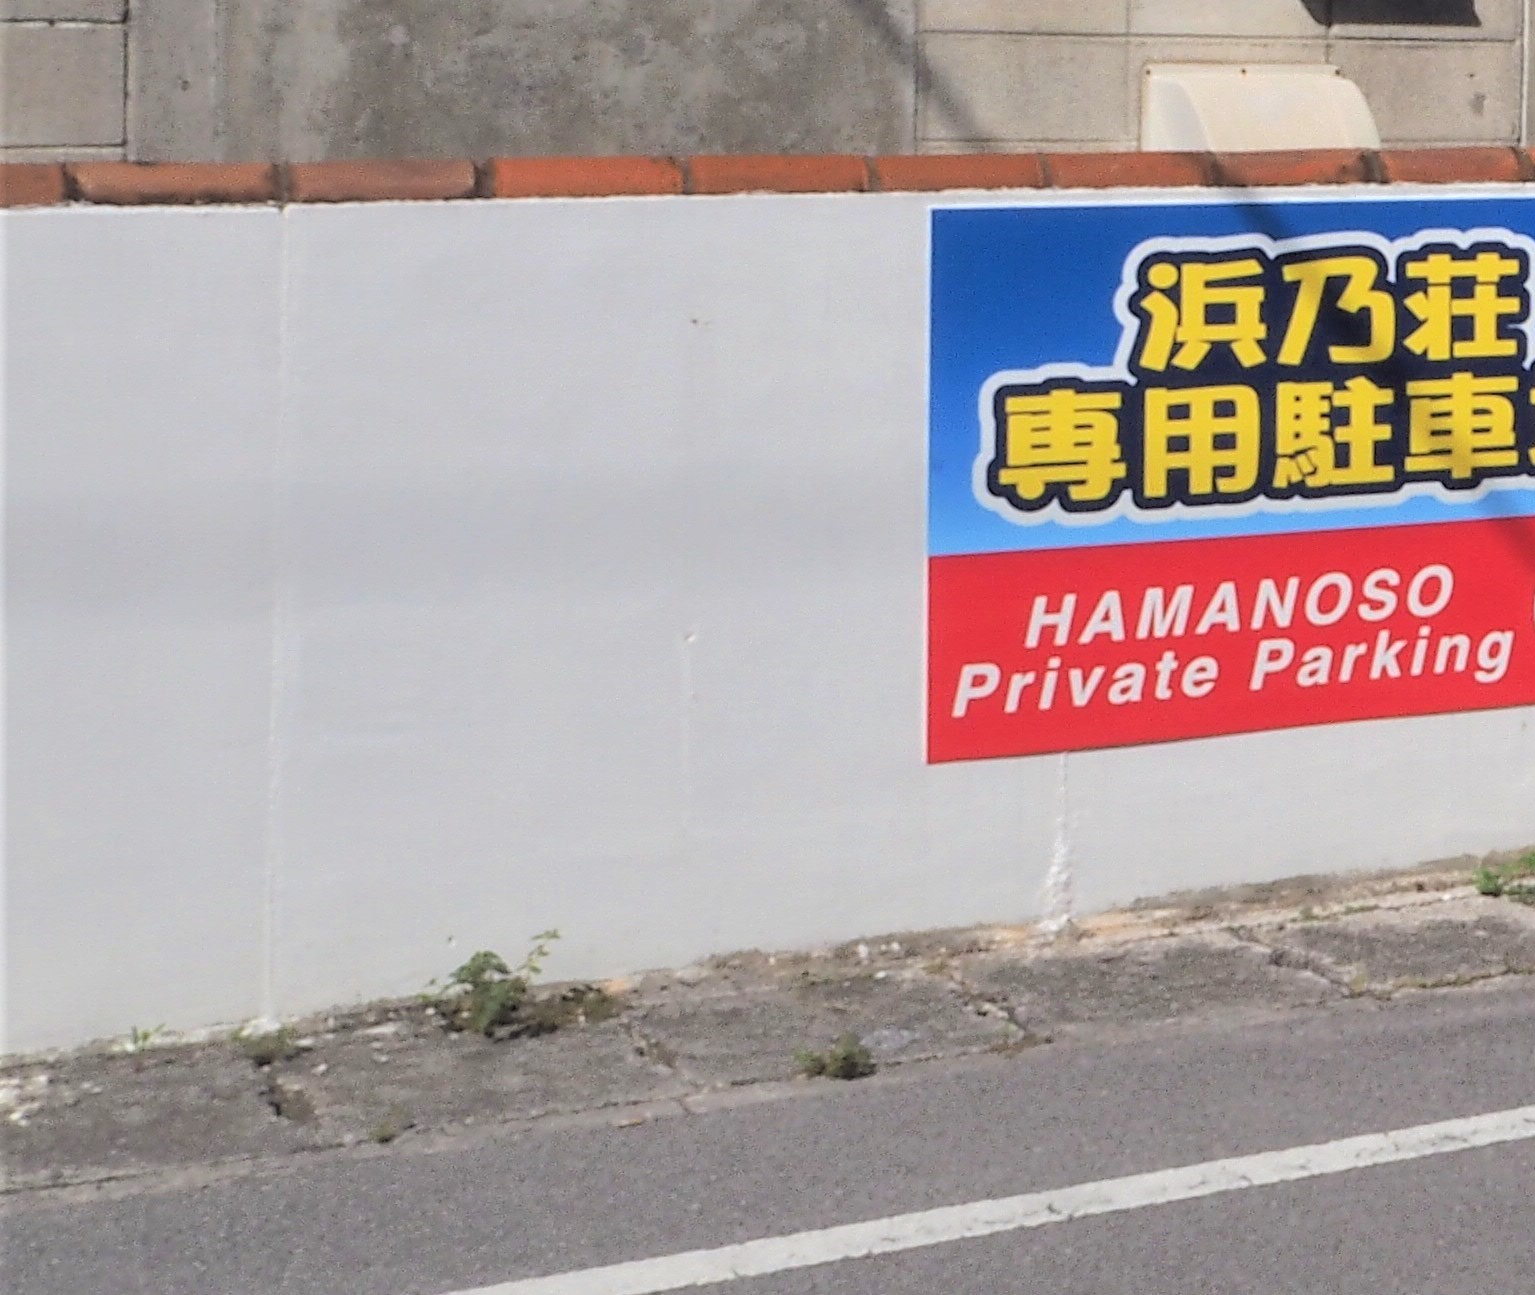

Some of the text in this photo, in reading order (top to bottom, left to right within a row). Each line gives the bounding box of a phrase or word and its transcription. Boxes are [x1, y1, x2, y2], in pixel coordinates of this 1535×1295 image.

[1138, 250, 1528, 373] 浜乃荘
[1024, 563, 1455, 649] HAMANOSO
[951, 626, 1515, 719] Private Parking
